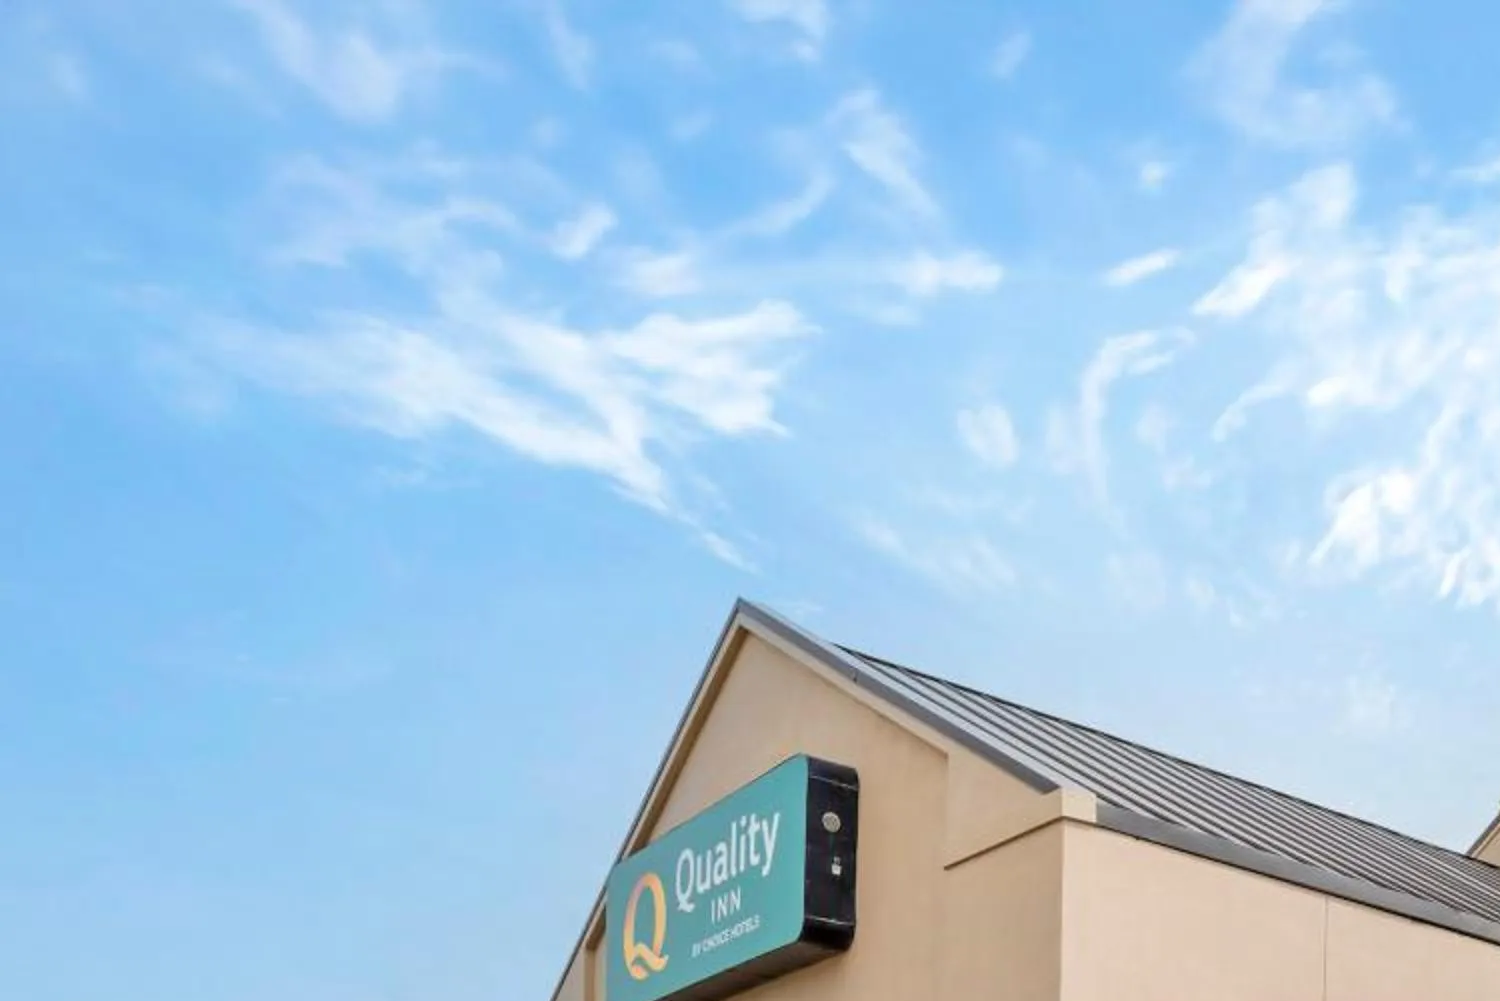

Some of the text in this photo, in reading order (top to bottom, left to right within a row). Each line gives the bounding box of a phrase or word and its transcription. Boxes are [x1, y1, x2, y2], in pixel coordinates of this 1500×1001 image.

[675, 812, 781, 913] Quality
[711, 885, 741, 924] INN
[623, 872, 669, 981] Q
